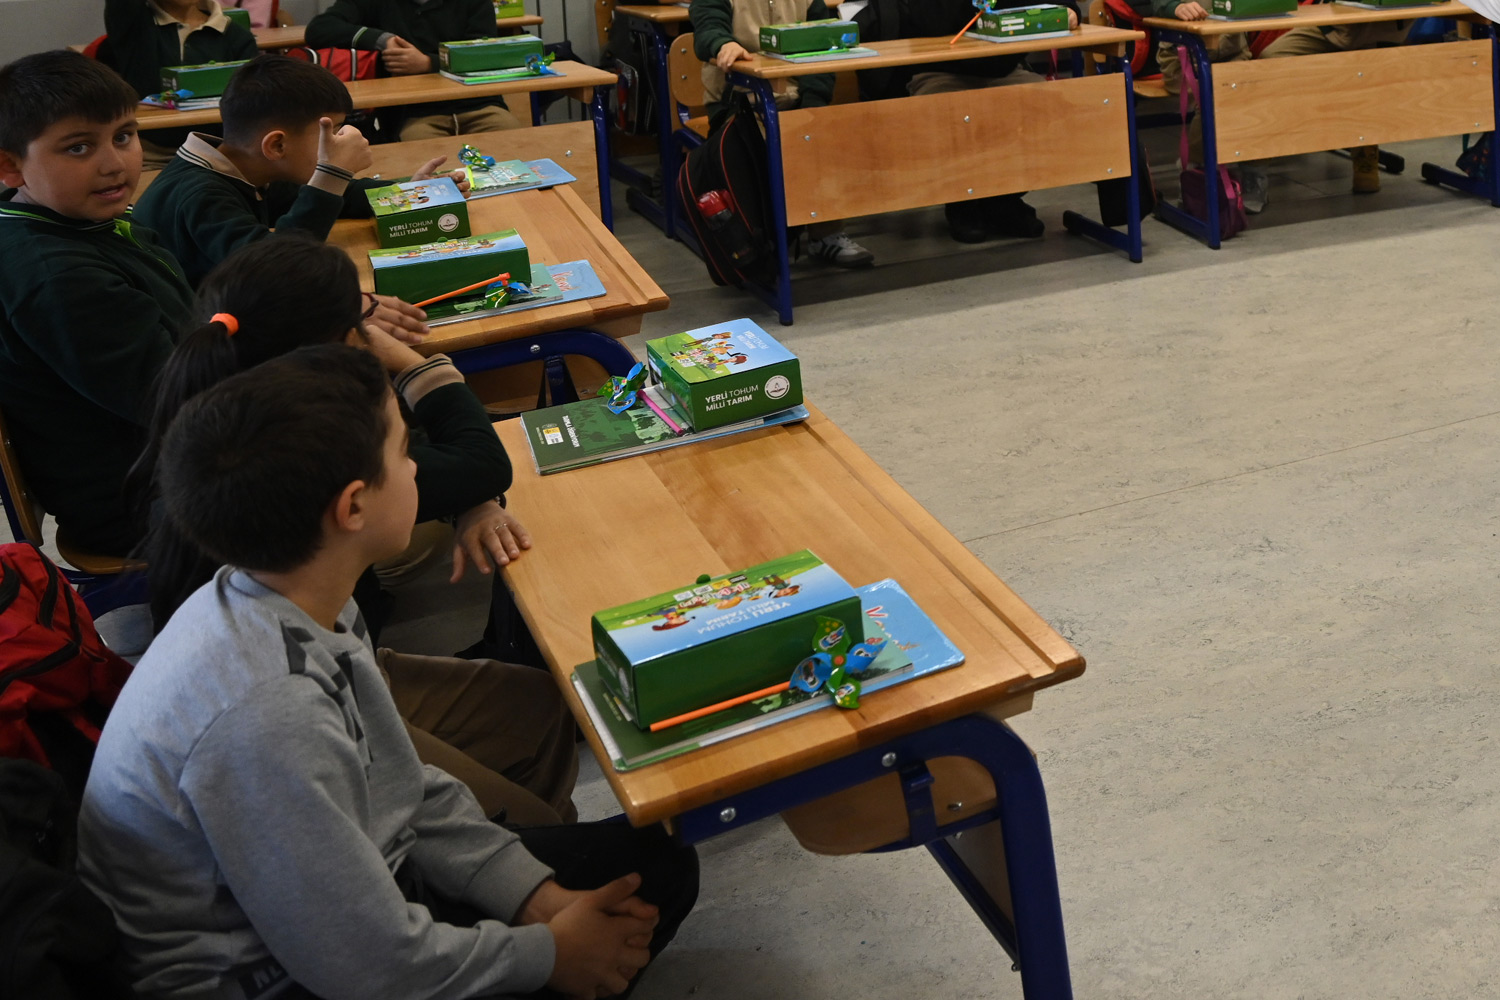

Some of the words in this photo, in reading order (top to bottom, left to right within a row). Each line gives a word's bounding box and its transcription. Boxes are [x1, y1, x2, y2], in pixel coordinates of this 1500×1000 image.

[389, 223, 408, 232] YERLİ
[408, 219, 433, 229] TOHUM
[389, 230, 406, 238] MİLLİ
[407, 226, 428, 235] TARIM
[705, 391, 728, 403] YERLİ
[728, 385, 759, 397] TOHUM
[705, 401, 726, 412] MİLLİ
[727, 394, 753, 406] TARIM
